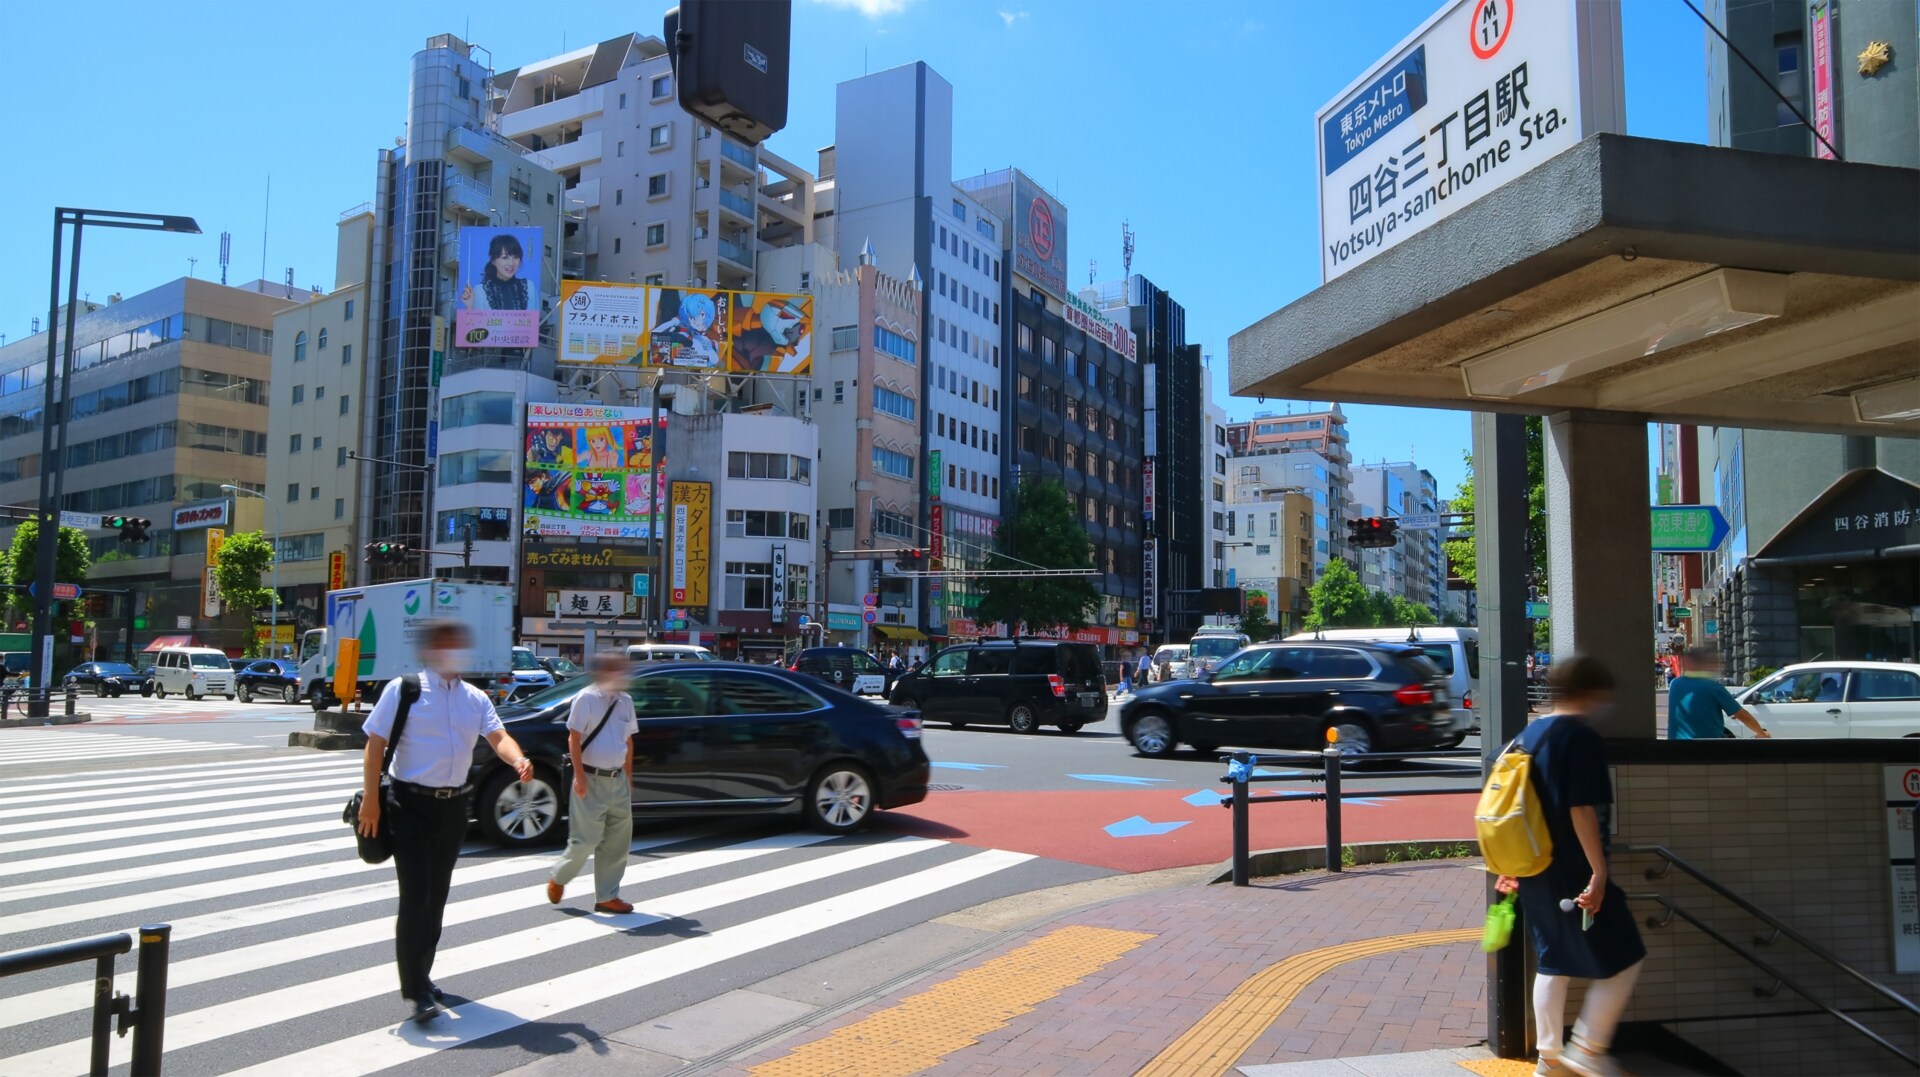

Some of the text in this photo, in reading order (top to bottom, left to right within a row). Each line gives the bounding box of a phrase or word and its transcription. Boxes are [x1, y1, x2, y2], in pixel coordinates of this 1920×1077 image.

[1483, 0, 1497, 24] M
[1482, 20, 1499, 46] 11
[1340, 69, 1407, 139] 東京メトロ
[1344, 103, 1403, 154] Tokyo Metro
[1349, 61, 1530, 225] 四谷三丁目駅
[1329, 107, 1567, 266] Yotsuya-sanchome Sta.
[574, 295, 588, 307] 湖
[490, 335, 530, 344] 中央建設
[529, 405, 623, 418] 「楽しい」は色あせない
[931, 452, 940, 495] サイゼリヤ
[675, 485, 709, 503] 漢方
[60, 513, 99, 526] 四谷三丁目
[676, 507, 686, 552] 四谷漢方堂
[1402, 515, 1438, 524] 四谷三丁目
[933, 517, 942, 558] サンドラッグ
[526, 549, 613, 566] 売ってみません?
[688, 507, 708, 603] ダイエット
[774, 553, 784, 607] きしめん
[1910, 774, 1919, 782] M
